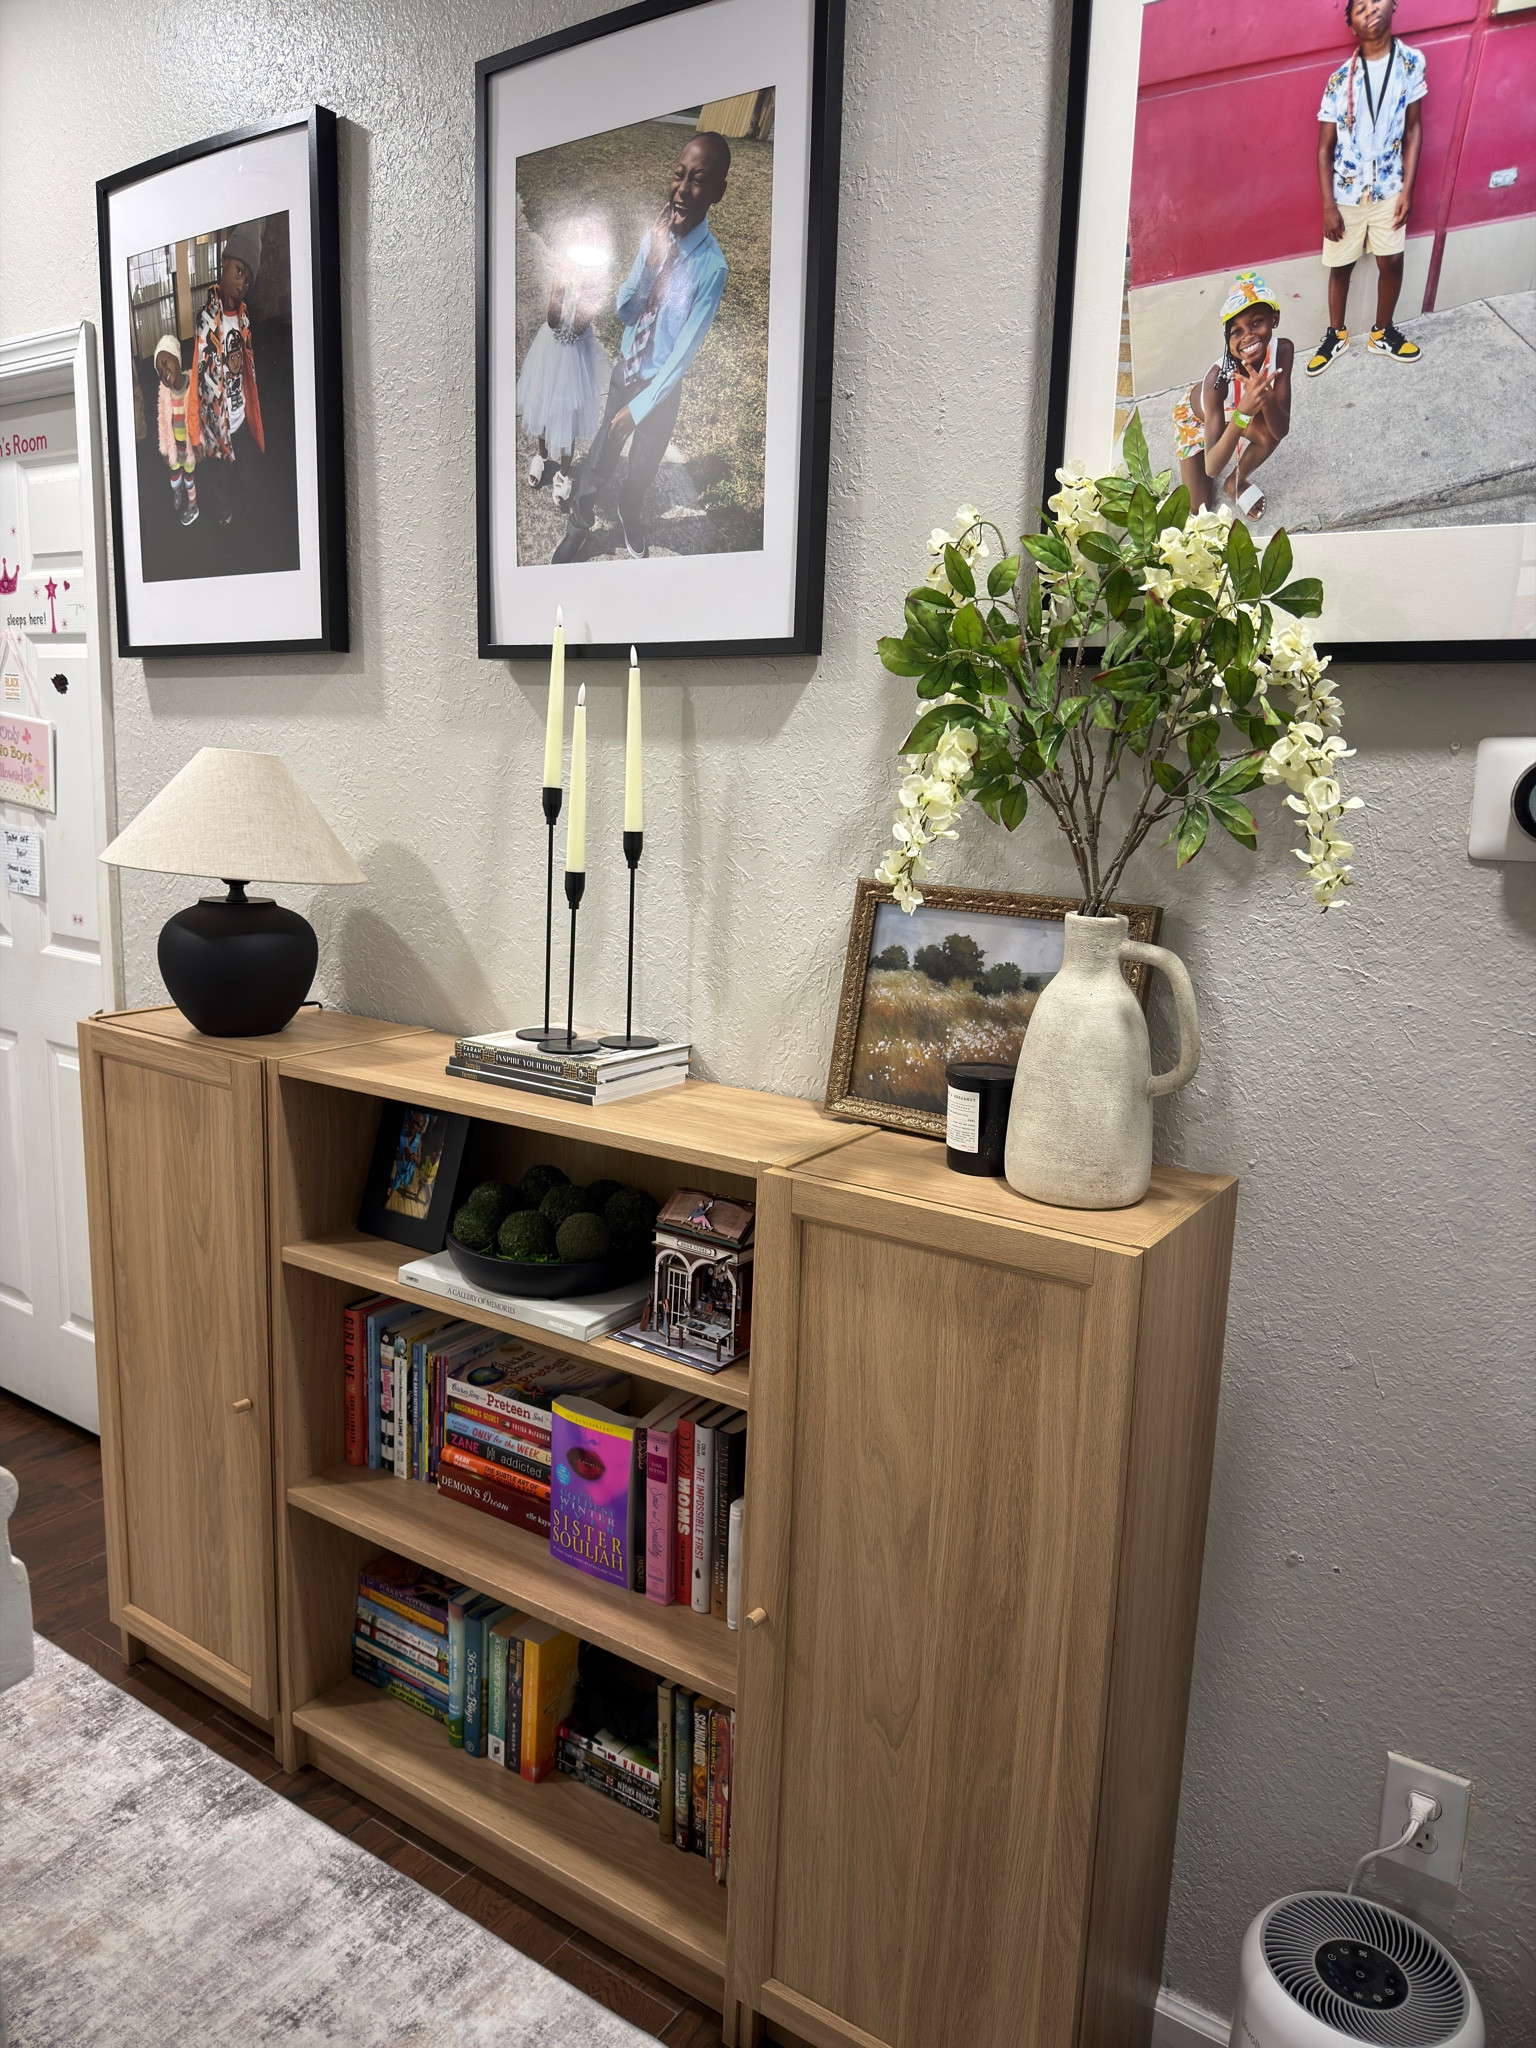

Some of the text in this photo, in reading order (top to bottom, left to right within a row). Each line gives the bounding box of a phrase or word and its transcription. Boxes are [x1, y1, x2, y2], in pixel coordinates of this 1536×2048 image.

[13, 434, 47, 455] Room
[7, 612, 47, 629] sleeps here!
[0, 726, 20, 745] Only
[10, 745, 33, 765] Boys
[495, 1053, 563, 1074] INSPIRE YOUR HOME
[452, 1289, 478, 1303] GALLERY
[478, 1298, 486, 1306] OF
[486, 1299, 517, 1315] MEMORIES
[344, 1317, 355, 1380] GIRL ONE
[453, 1401, 482, 1417] HOUSEMAID'S
[483, 1412, 499, 1424] SECRET
[468, 1390, 480, 1400] Soup
[487, 1393, 531, 1420] Preteen
[532, 1413, 544, 1423] Soul
[575, 1418, 613, 1433] ANNIVERSARY
[450, 1433, 480, 1454] ZANE
[472, 1427, 540, 1459] ONLY for the WEEK
[453, 1454, 470, 1465] MARK
[501, 1455, 542, 1478] addicted
[484, 1466, 539, 1491] THE SUBTLE ART OF
[441, 1475, 509, 1511] DEMON'S Dream
[719, 1446, 729, 1546] SISTER SOULJAH
[560, 1496, 615, 1527] WINTER
[677, 1476, 690, 1536] MOMS
[695, 1466, 705, 1560] THE IMPOSSIBLE FIRST
[553, 1509, 621, 1555] SISTER
[553, 1525, 623, 1572] SOULJAH
[466, 1649, 477, 1673] 365
[493, 1644, 501, 1687] STUDENT'S
[464, 1695, 477, 1723] Boys
[694, 1712, 706, 1766] SCANDALOUS
[622, 1759, 652, 1782] NANA
[694, 1812, 702, 1831] SHEN
